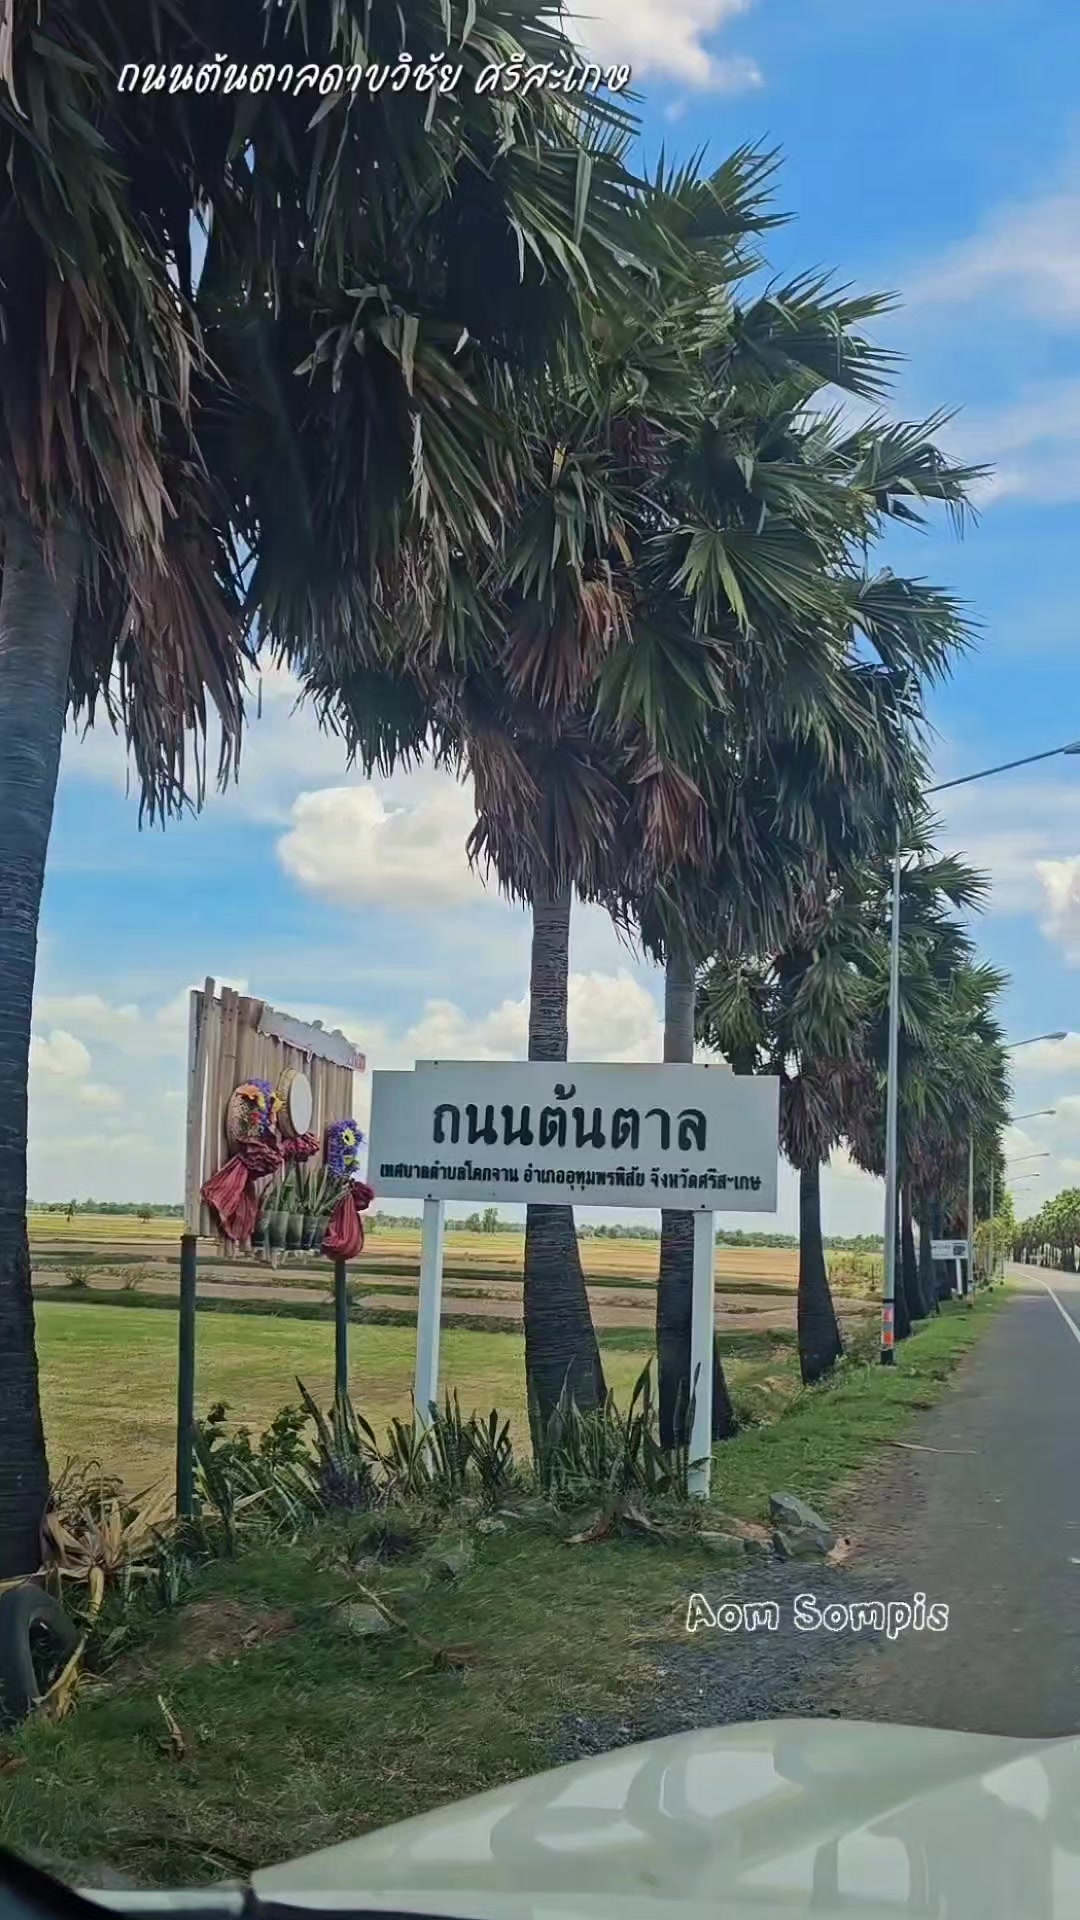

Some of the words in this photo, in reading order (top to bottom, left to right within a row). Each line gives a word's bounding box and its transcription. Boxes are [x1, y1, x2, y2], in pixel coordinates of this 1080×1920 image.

[432, 1083, 707, 1152] ถนนต้นตาล
[380, 1160, 519, 1182] เทศบาลตำบลโคกจาน
[523, 1163, 646, 1191] อำเภออุทุมพรพิสัย
[650, 1167, 762, 1191] จังหวัดศรีสะเกษ
